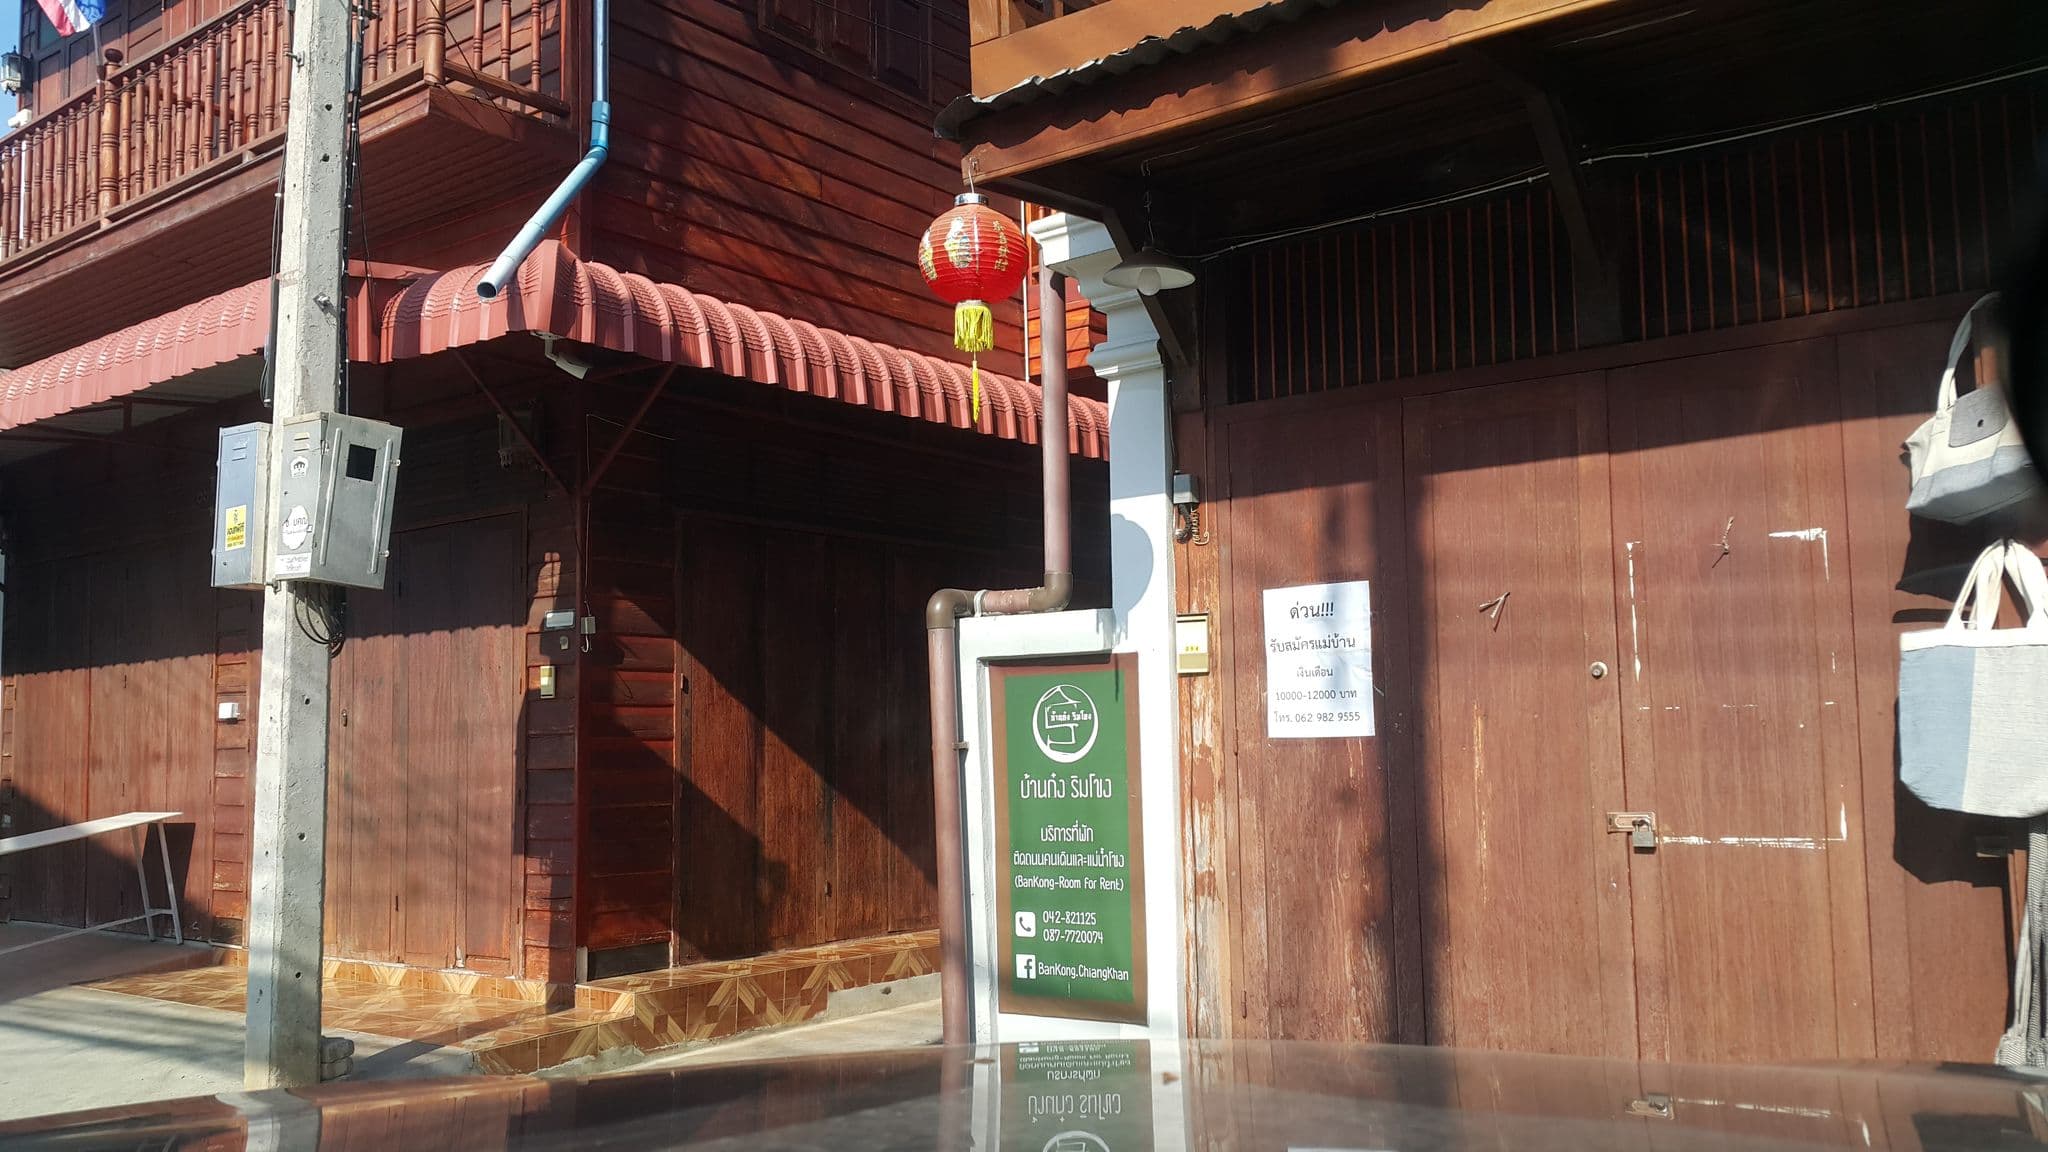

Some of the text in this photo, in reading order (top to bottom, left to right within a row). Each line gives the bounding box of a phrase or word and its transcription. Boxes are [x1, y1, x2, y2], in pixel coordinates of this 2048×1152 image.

[1289, 601, 1334, 619] ด่วน!!!
[1269, 632, 1356, 653] รับสมัครแม่บ้าน
[1296, 665, 1334, 678] เงินเดือน
[1276, 689, 1357, 701] 10000-12000 บาท
[1273, 711, 1361, 723] โทร. 062 982 9555
[1070, 773, 1112, 798] ริมโขง
[1040, 820, 1094, 842] บริการที่พัก
[1013, 847, 1125, 868] ติดถนนคนเดินและแม่น้ำโขง
[1014, 874, 1081, 891] (BanKong-Room
[1099, 877, 1124, 891] Rent)
[1042, 910, 1097, 925] 042-821125
[1043, 929, 1104, 944] 087-7720074
[1038, 961, 1129, 981] BanKong.ChiangKhan
